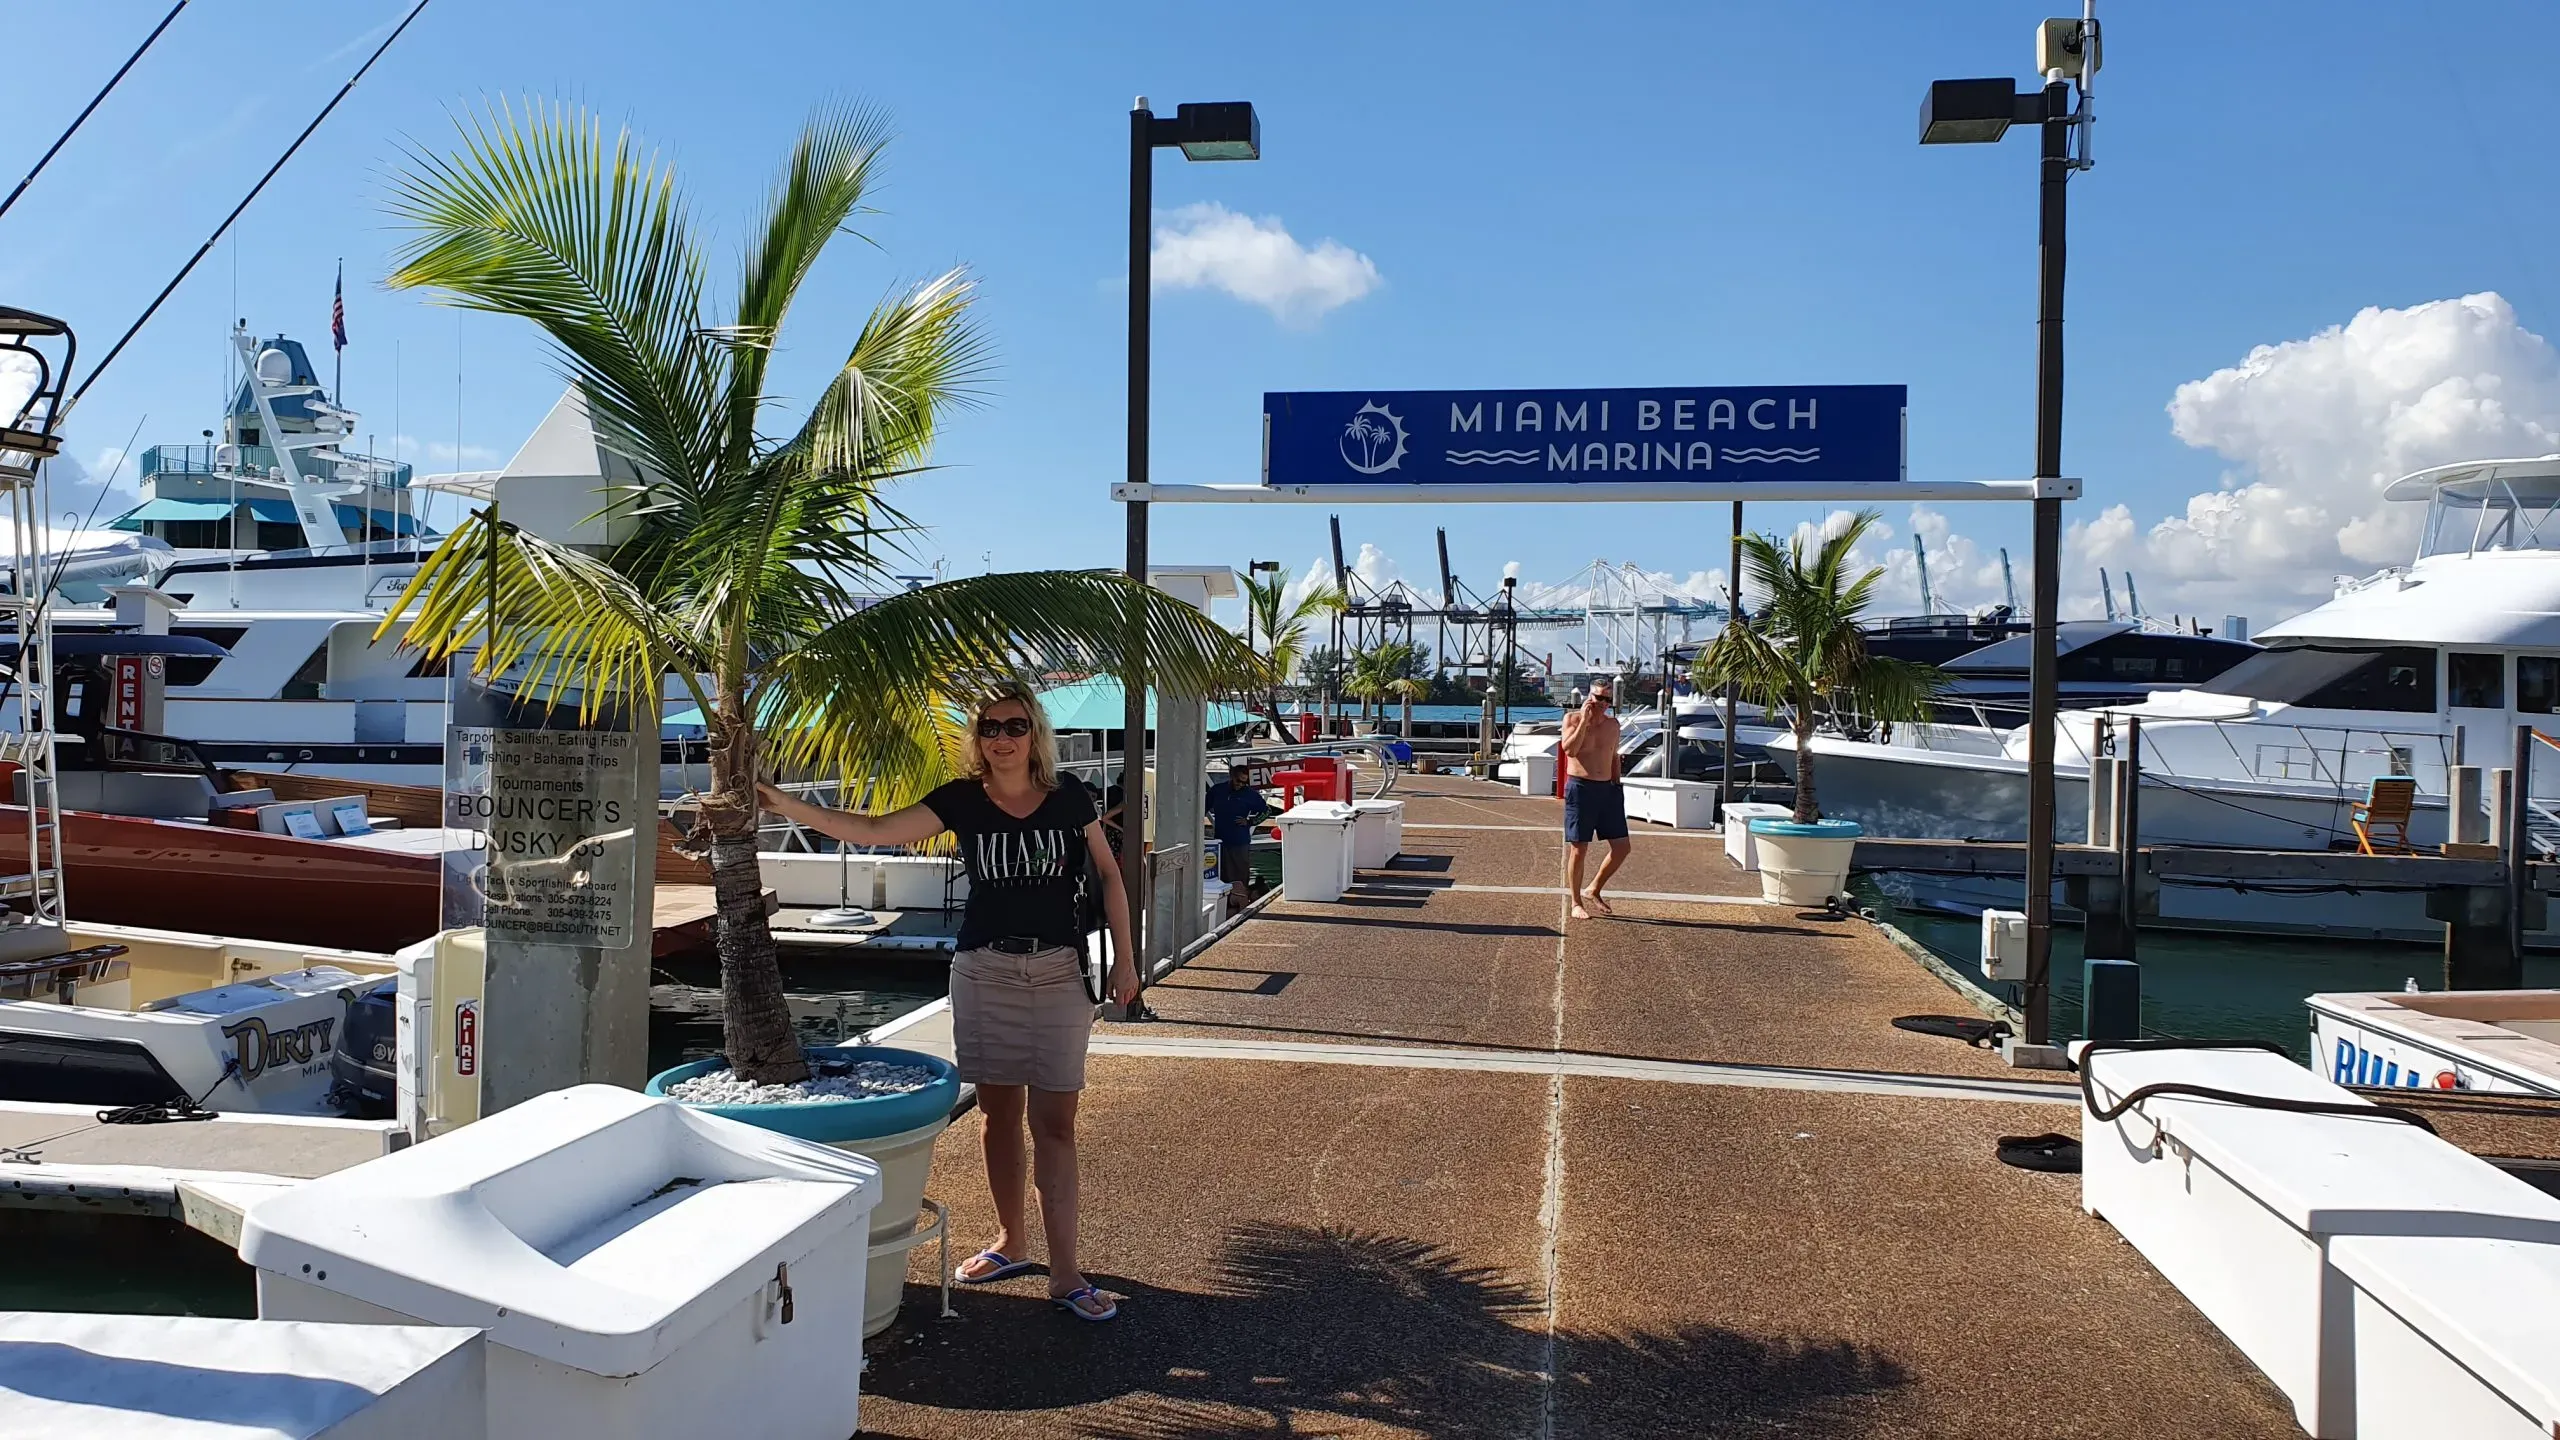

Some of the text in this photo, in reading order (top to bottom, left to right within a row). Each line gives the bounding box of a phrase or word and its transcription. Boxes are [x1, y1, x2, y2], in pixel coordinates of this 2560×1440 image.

[1449, 398, 1818, 433] MIAMI BEACH
[1546, 441, 1713, 472] MARINA
[456, 731, 627, 749] Tarpon, Sailfish, Eating Fish
[534, 753, 584, 766] Bahama
[588, 754, 618, 768] Trips
[495, 776, 584, 793] Tournaments
[458, 795, 620, 823] BOUNCER'S
[472, 830, 565, 855] DUSKY
[975, 829, 1065, 881] MIAMI
[483, 890, 545, 904] Resevations:
[501, 905, 534, 917] Phone:
[221, 1017, 335, 1082] DIRTY
[461, 1017, 473, 1071] FIRE
